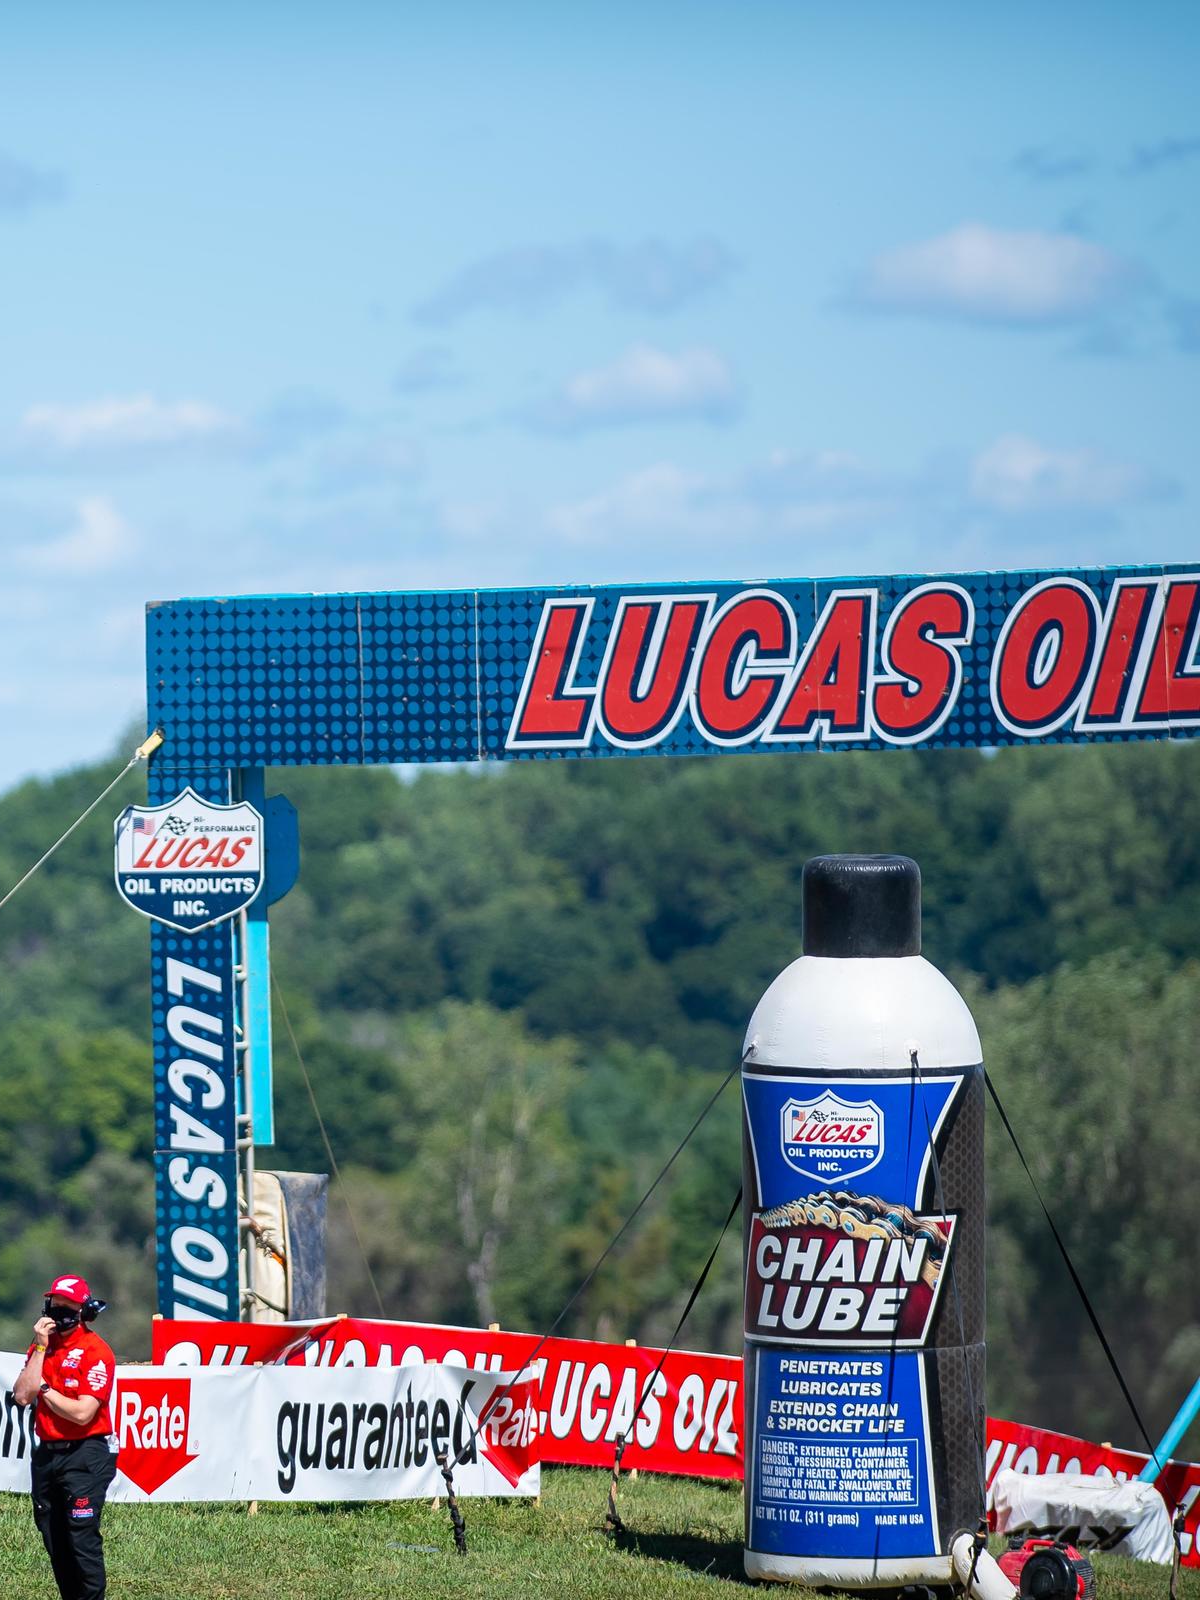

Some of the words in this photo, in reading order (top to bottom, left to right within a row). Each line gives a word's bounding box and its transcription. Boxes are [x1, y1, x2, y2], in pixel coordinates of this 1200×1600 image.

[506, 581, 975, 748] LUCAS
[991, 574, 1200, 737] OIL
[132, 837, 253, 868] LUCAS
[125, 878, 155, 895] OIL
[161, 877, 256, 894] PRODUCTS
[173, 900, 210, 916] INC.
[166, 957, 227, 1210] LUCAS
[792, 1123, 872, 1143] LUCAS
[788, 1147, 805, 1157] OIL
[809, 1148, 875, 1159] PRODUCTS
[817, 1162, 842, 1171] INC.
[756, 1234, 927, 1282] CHAIN
[757, 1284, 908, 1332] LUBE
[780, 1359, 883, 1375] PENETRATES
[780, 1380, 882, 1396] LUBRICATES
[673, 1374, 739, 1455] OIL
[770, 1400, 837, 1416] EXTENDS
[842, 1403, 898, 1417] CHAIN
[120, 1391, 185, 1449] Rate
[766, 1416, 775, 1429] &
[778, 1417, 864, 1432] SPROCKET
[868, 1419, 905, 1433] LIFE
[277, 1379, 478, 1495] guaranteed
[762, 1439, 798, 1455] DANGER:
[800, 1446, 849, 1457] EXTREMELY
[852, 1446, 908, 1457] FLAMMABLE
[762, 1454, 792, 1466] AEROSOL.
[794, 1456, 852, 1468] PRESSURIZED
[855, 1458, 909, 1468] CONTAINER:
[762, 1464, 773, 1475] MAY
[775, 1466, 795, 1477] BURST
[797, 1468, 804, 1477] IF
[806, 1468, 839, 1479] HEATED.
[841, 1469, 869, 1479] VAPOR
[871, 1469, 914, 1479] HARMFUL.
[762, 1476, 790, 1488] HARMFUL
[792, 1479, 802, 1488] OR
[804, 1479, 826, 1490] FATAL
[828, 1480, 836, 1490] IF
[839, 1480, 894, 1491] SWALLOWED.
[896, 1480, 911, 1490] EYE
[762, 1487, 788, 1499] IRRITANT.
[789, 1489, 806, 1500] READ
[808, 1490, 849, 1501] WARNINGS
[851, 1491, 863, 1502] ON
[864, 1491, 887, 1502] BACK
[888, 1491, 914, 1502] PANEL.
[755, 1505, 765, 1519] NET
[766, 1507, 777, 1520] WT.
[779, 1508, 787, 1521] 11
[789, 1509, 803, 1523] OZ.
[805, 1510, 824, 1526] (311
[827, 1511, 859, 1528] grams)
[875, 1514, 897, 1525] MADE
[899, 1514, 907, 1525] IN
[910, 1513, 924, 1525] USA
